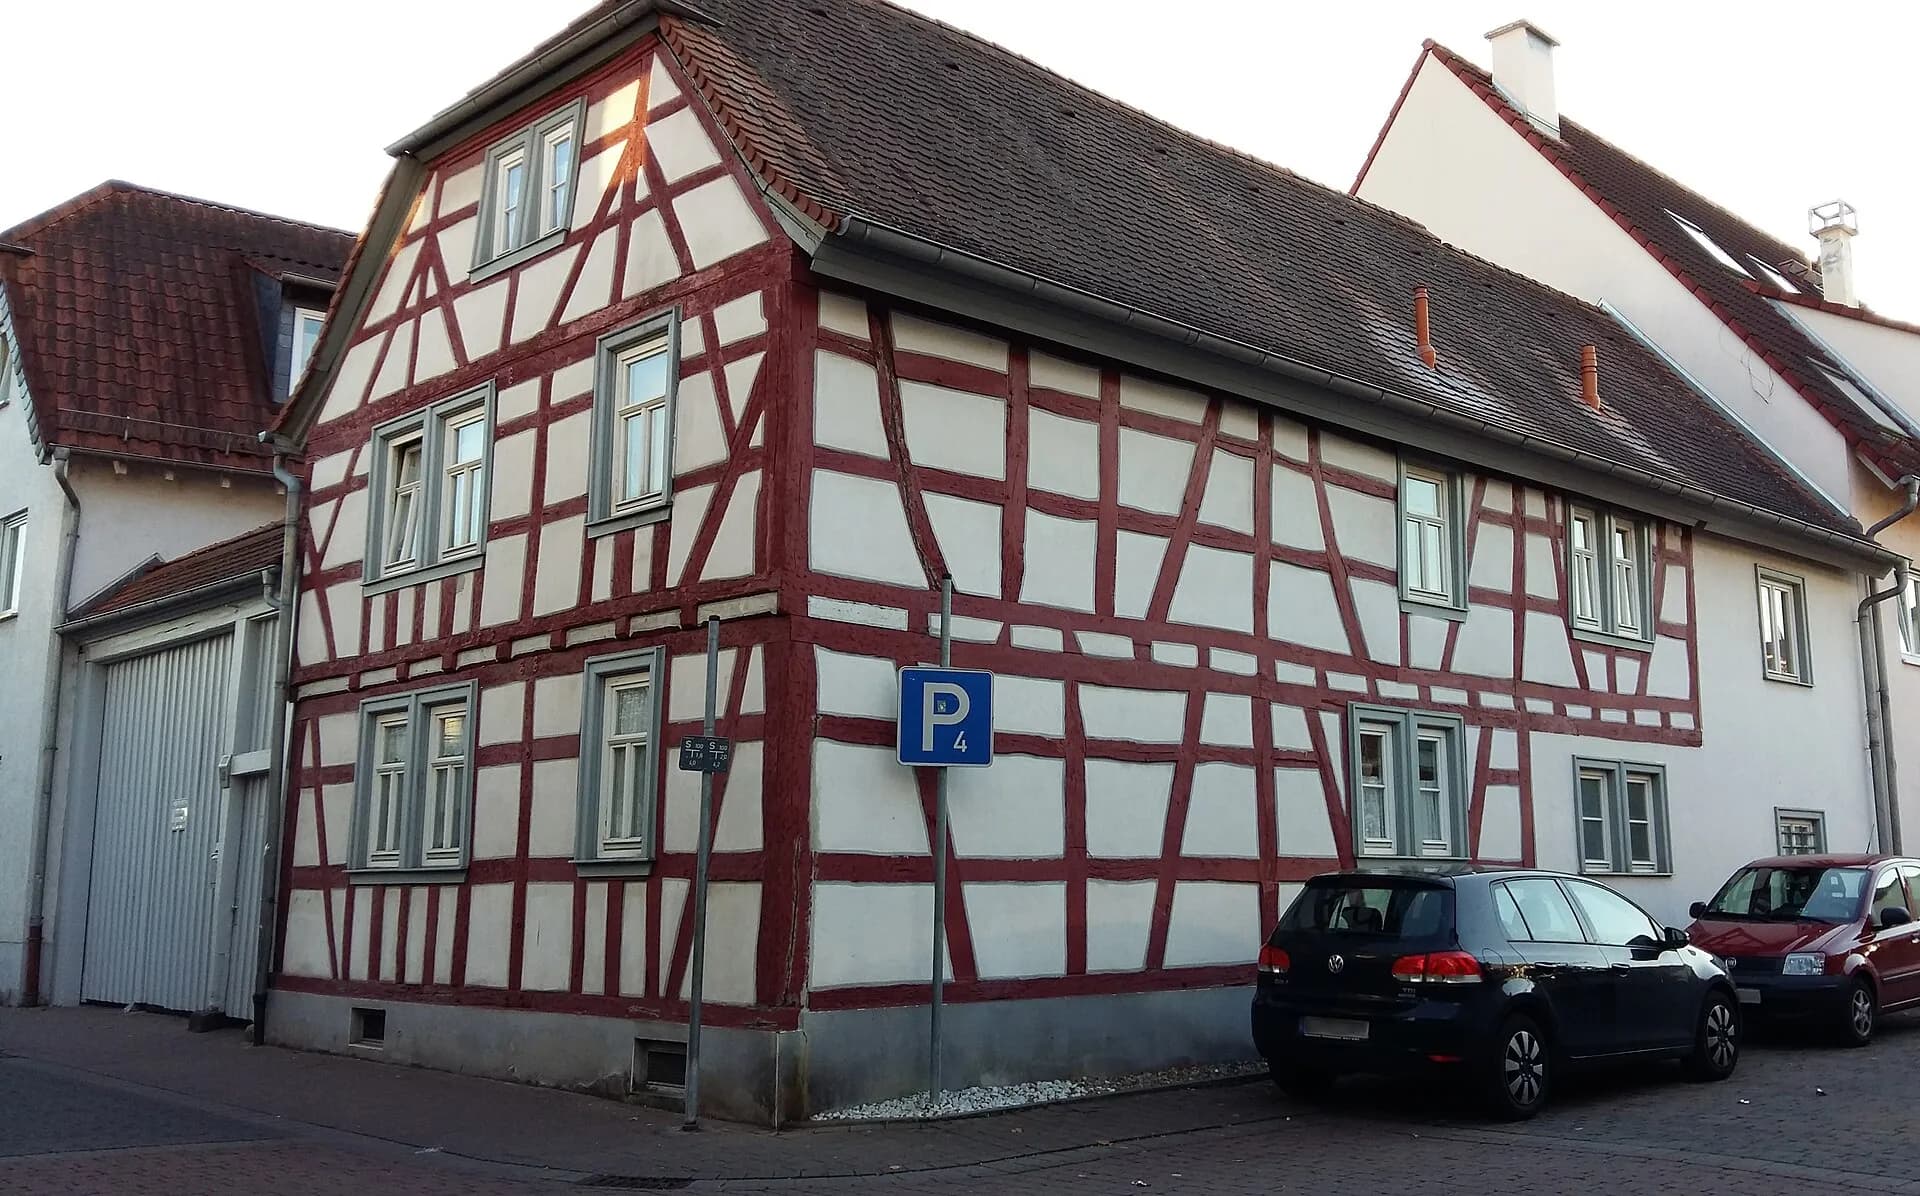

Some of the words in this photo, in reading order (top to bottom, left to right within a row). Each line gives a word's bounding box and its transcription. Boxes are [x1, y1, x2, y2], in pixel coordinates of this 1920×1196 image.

[922, 681, 970, 752] P
[685, 740, 692, 748] S
[709, 741, 716, 750] S
[953, 730, 968, 753] 4
